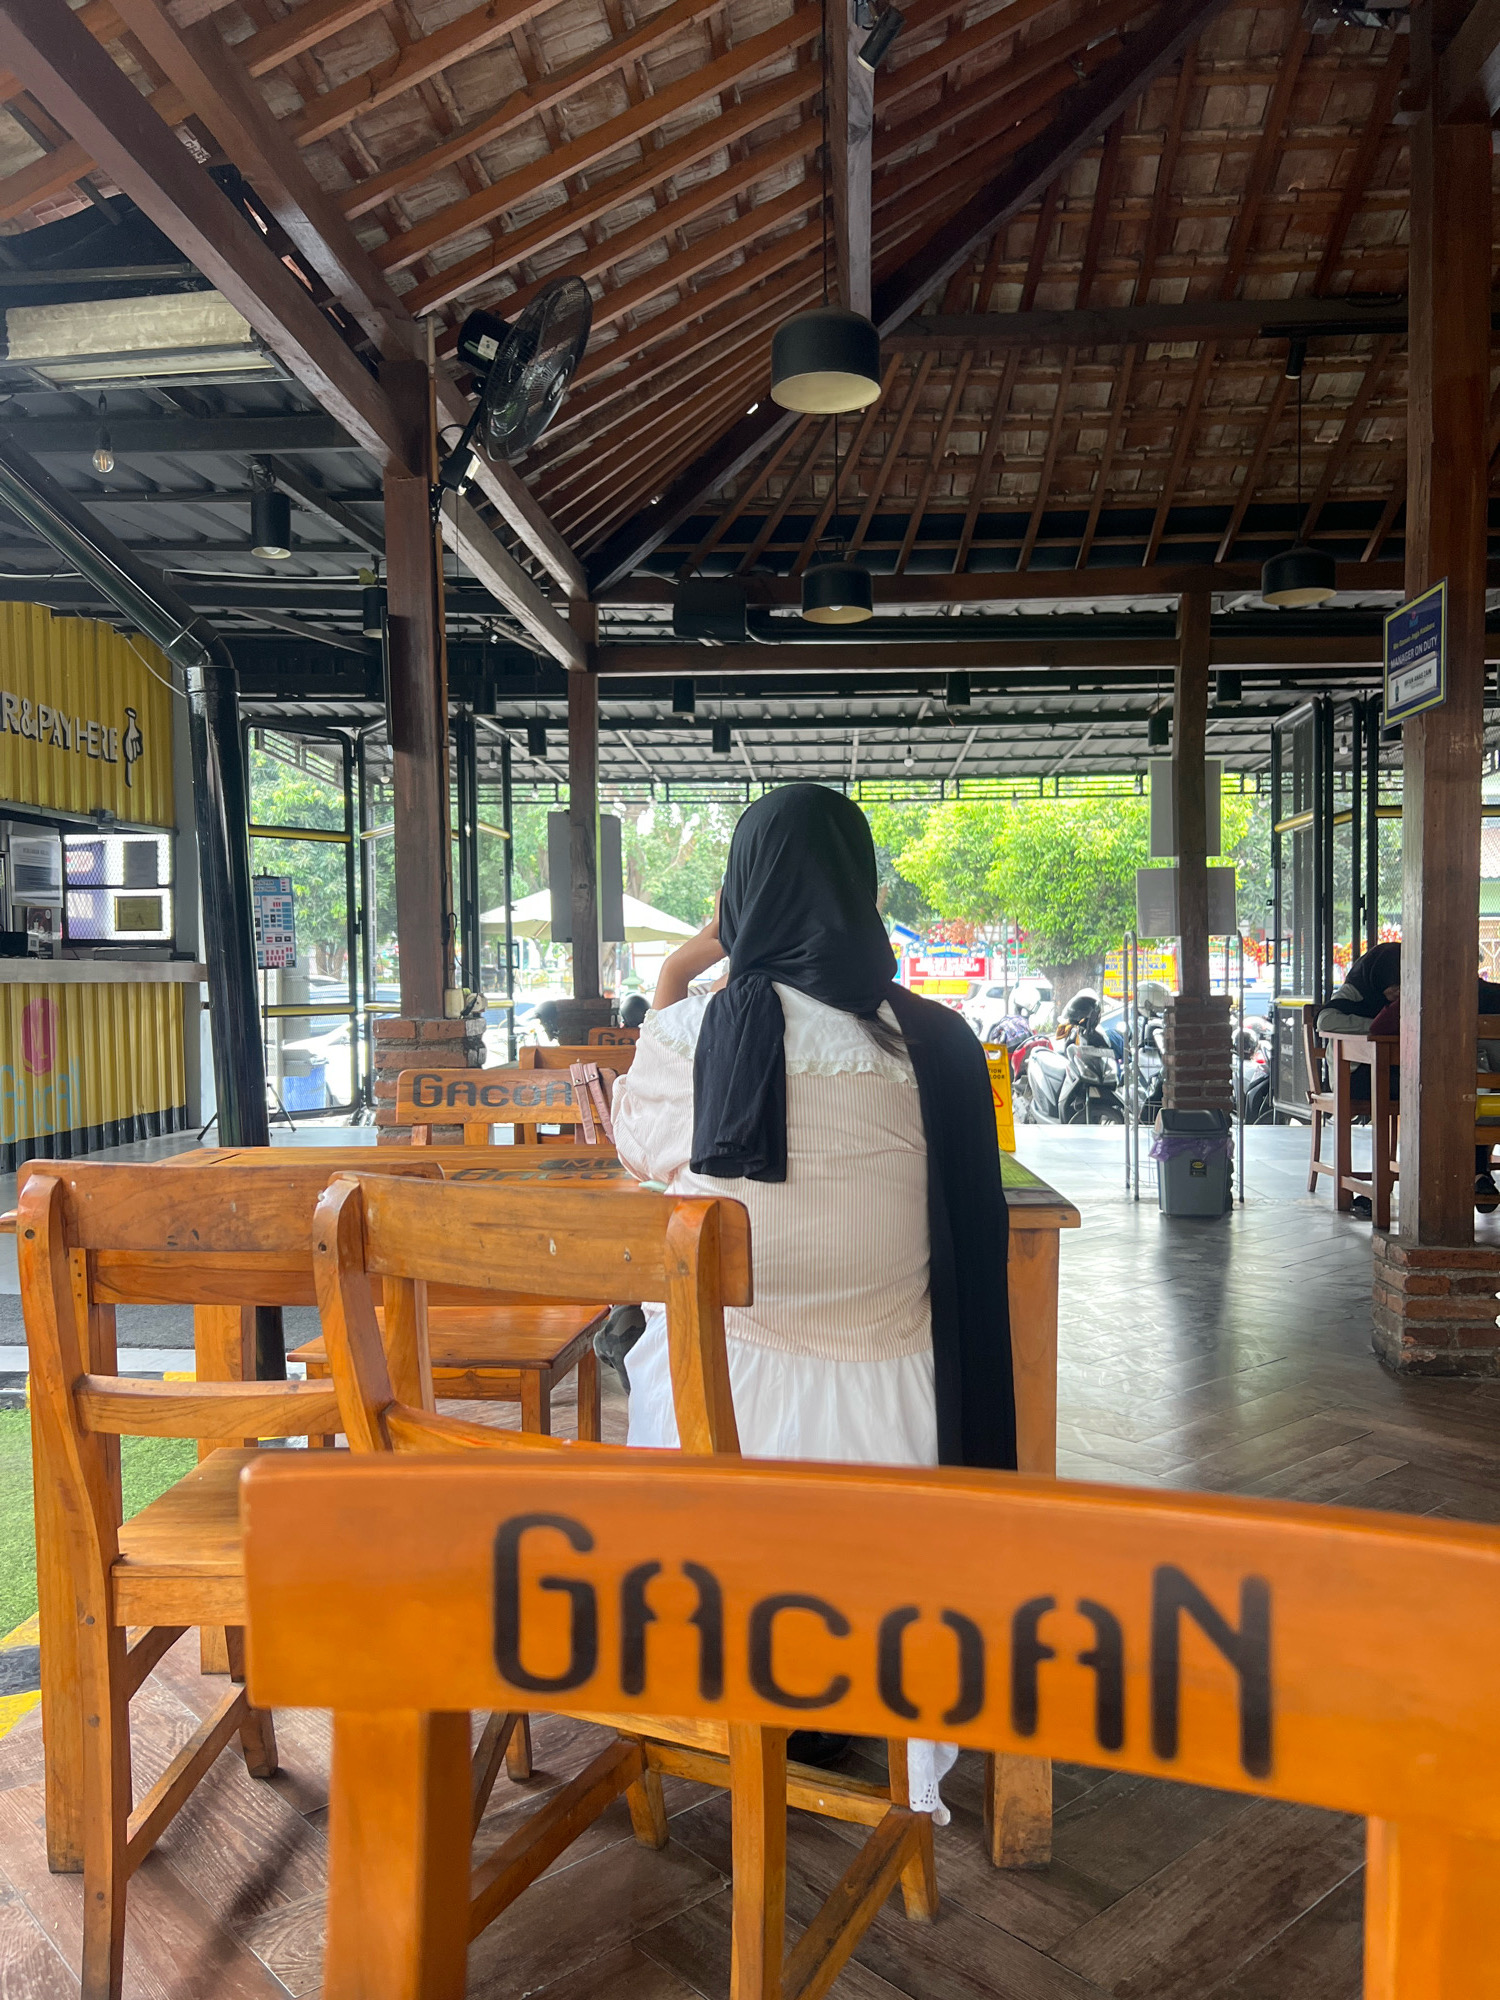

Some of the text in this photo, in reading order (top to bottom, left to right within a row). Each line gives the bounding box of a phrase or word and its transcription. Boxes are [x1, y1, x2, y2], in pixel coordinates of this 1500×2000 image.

[1390, 634, 1438, 669] MANAGER ON DUTY
[75, 717, 118, 763] HERE
[493, 1512, 1273, 1779] GACOAN
